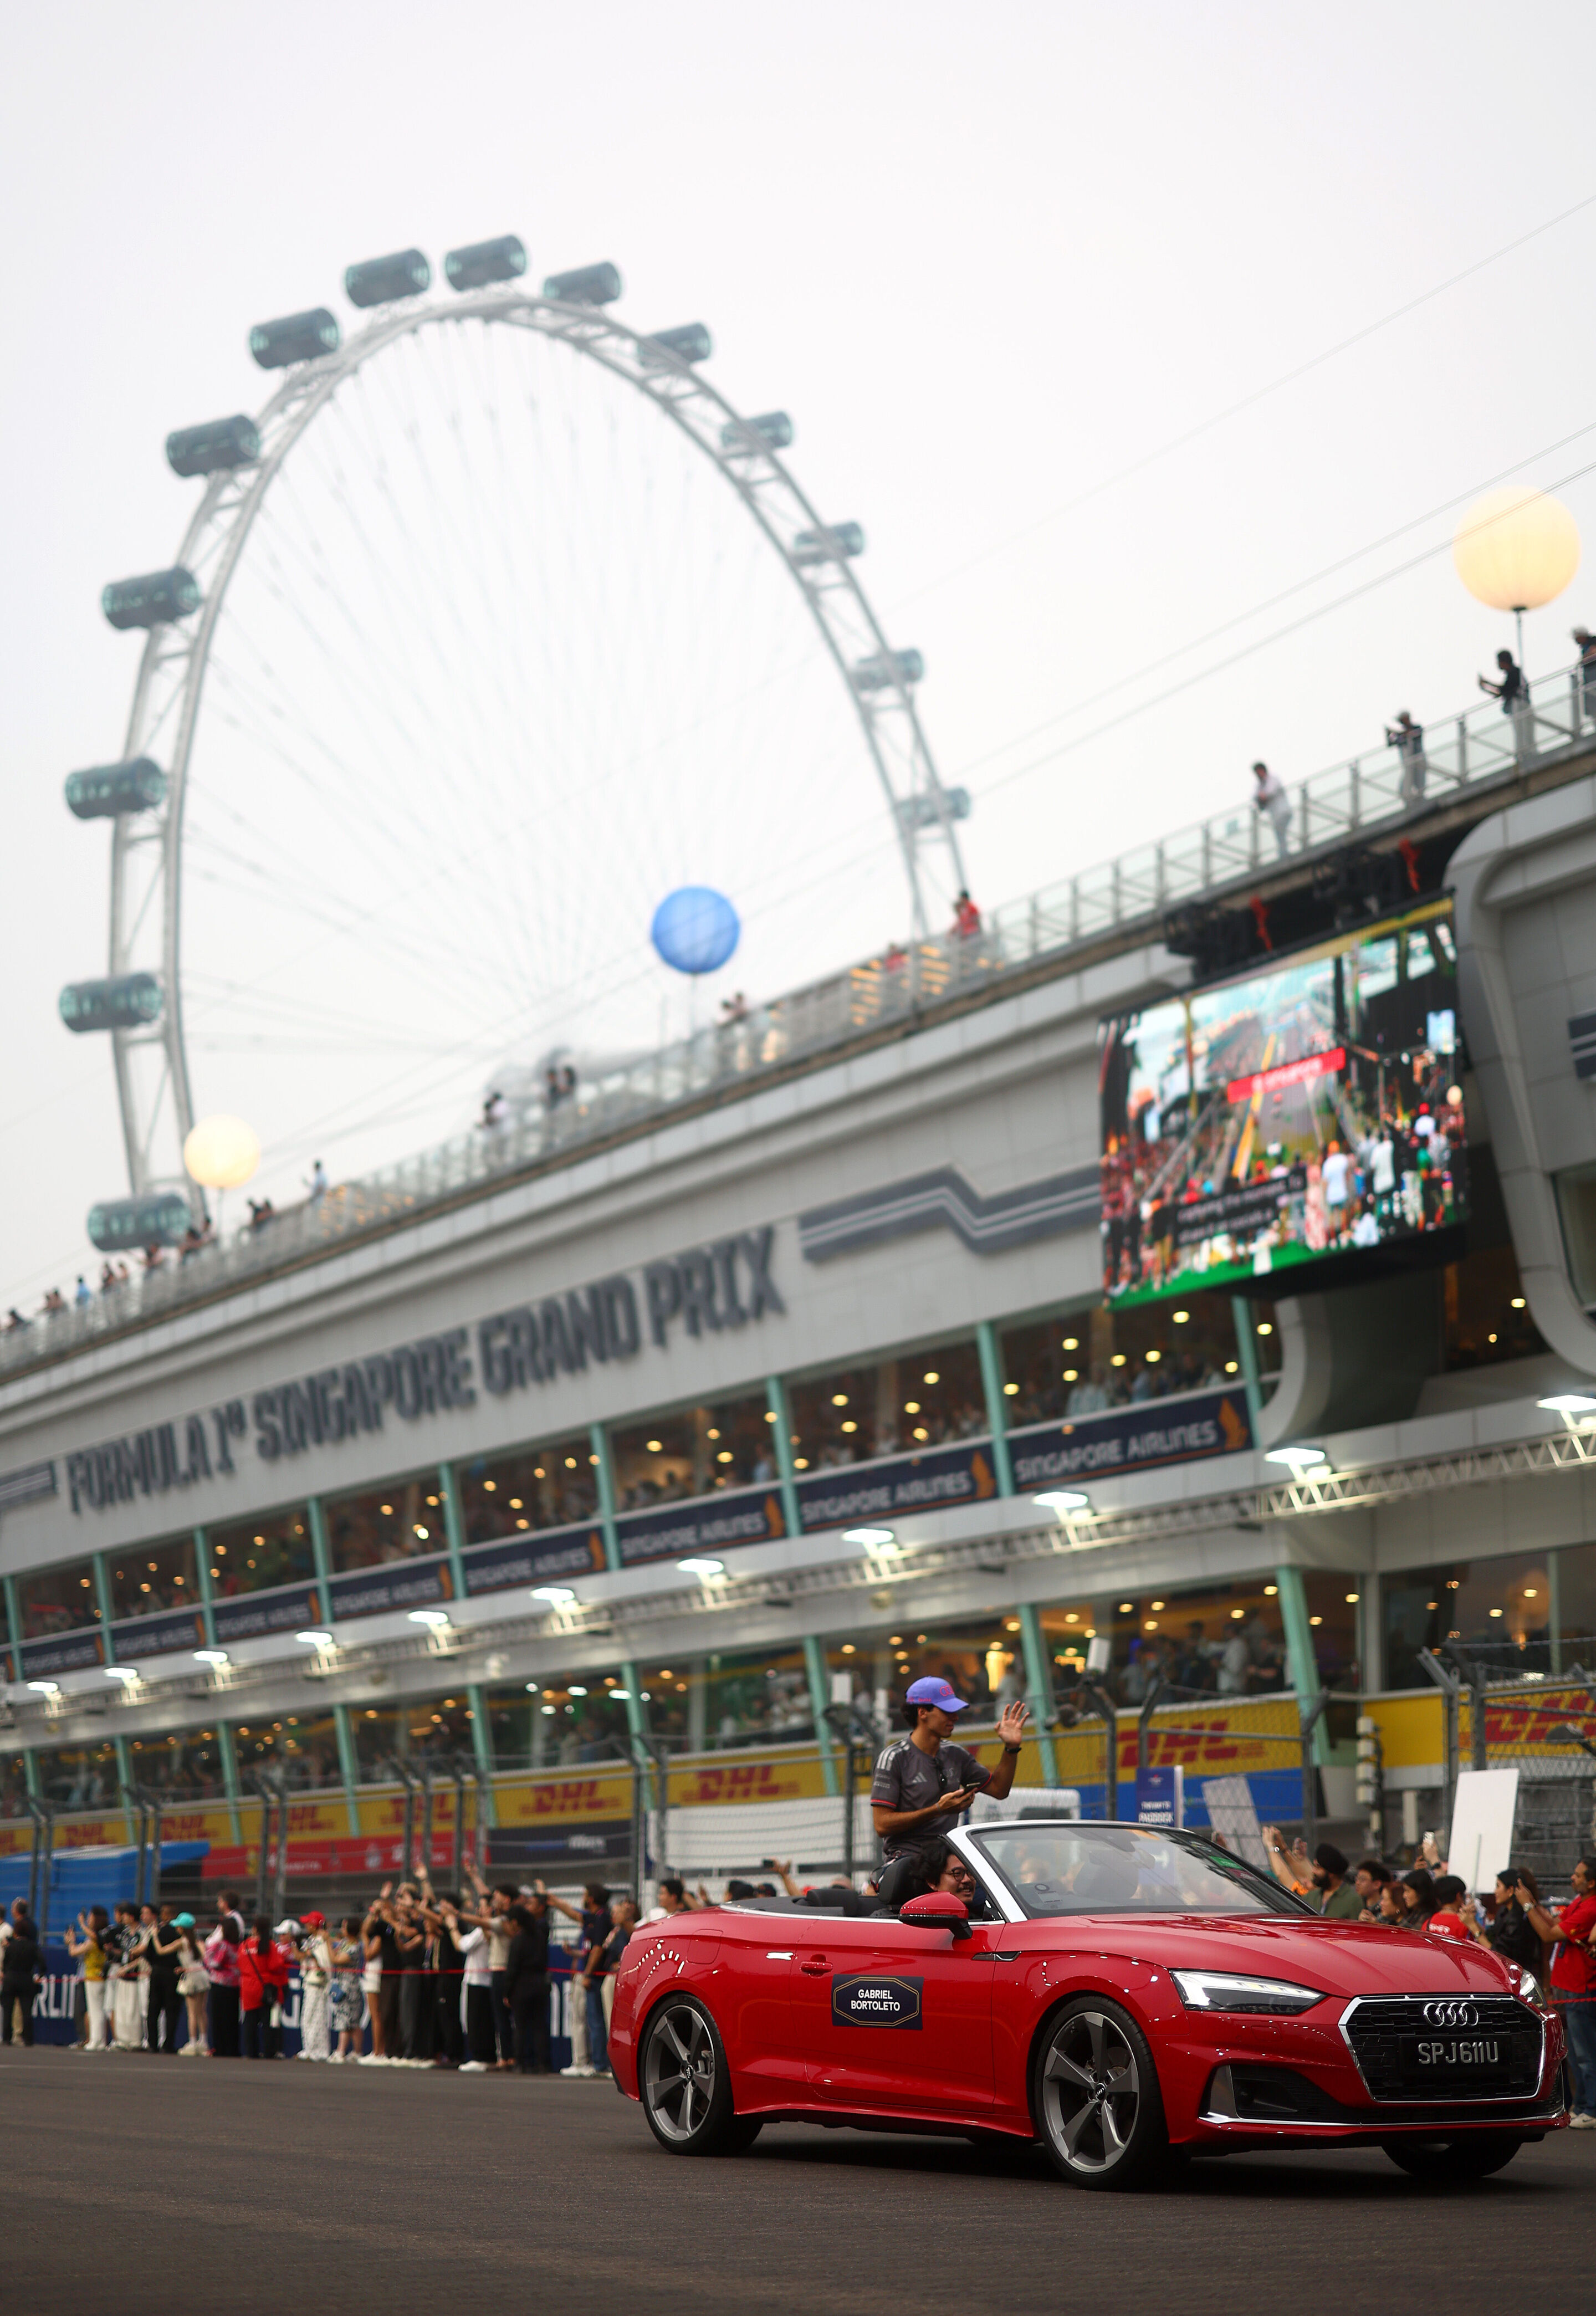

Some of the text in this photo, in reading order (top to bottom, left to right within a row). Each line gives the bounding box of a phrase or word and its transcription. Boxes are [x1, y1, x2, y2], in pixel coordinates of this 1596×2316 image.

[66, 1415, 212, 1514] FORMULA
[253, 1327, 477, 1460] SINGAPORE
[478, 1274, 641, 1396] GRAND
[643, 1224, 786, 1347] PRIX
[1015, 1420, 1218, 1482] SINGAPORE AIRLINES
[1117, 1720, 1238, 1767] DHL
[533, 1781, 605, 1813] DHL
[697, 1765, 780, 1801] DHL
[851, 2000, 901, 2011] BORTOLETO
[858, 1989, 893, 2000] GABRIEL
